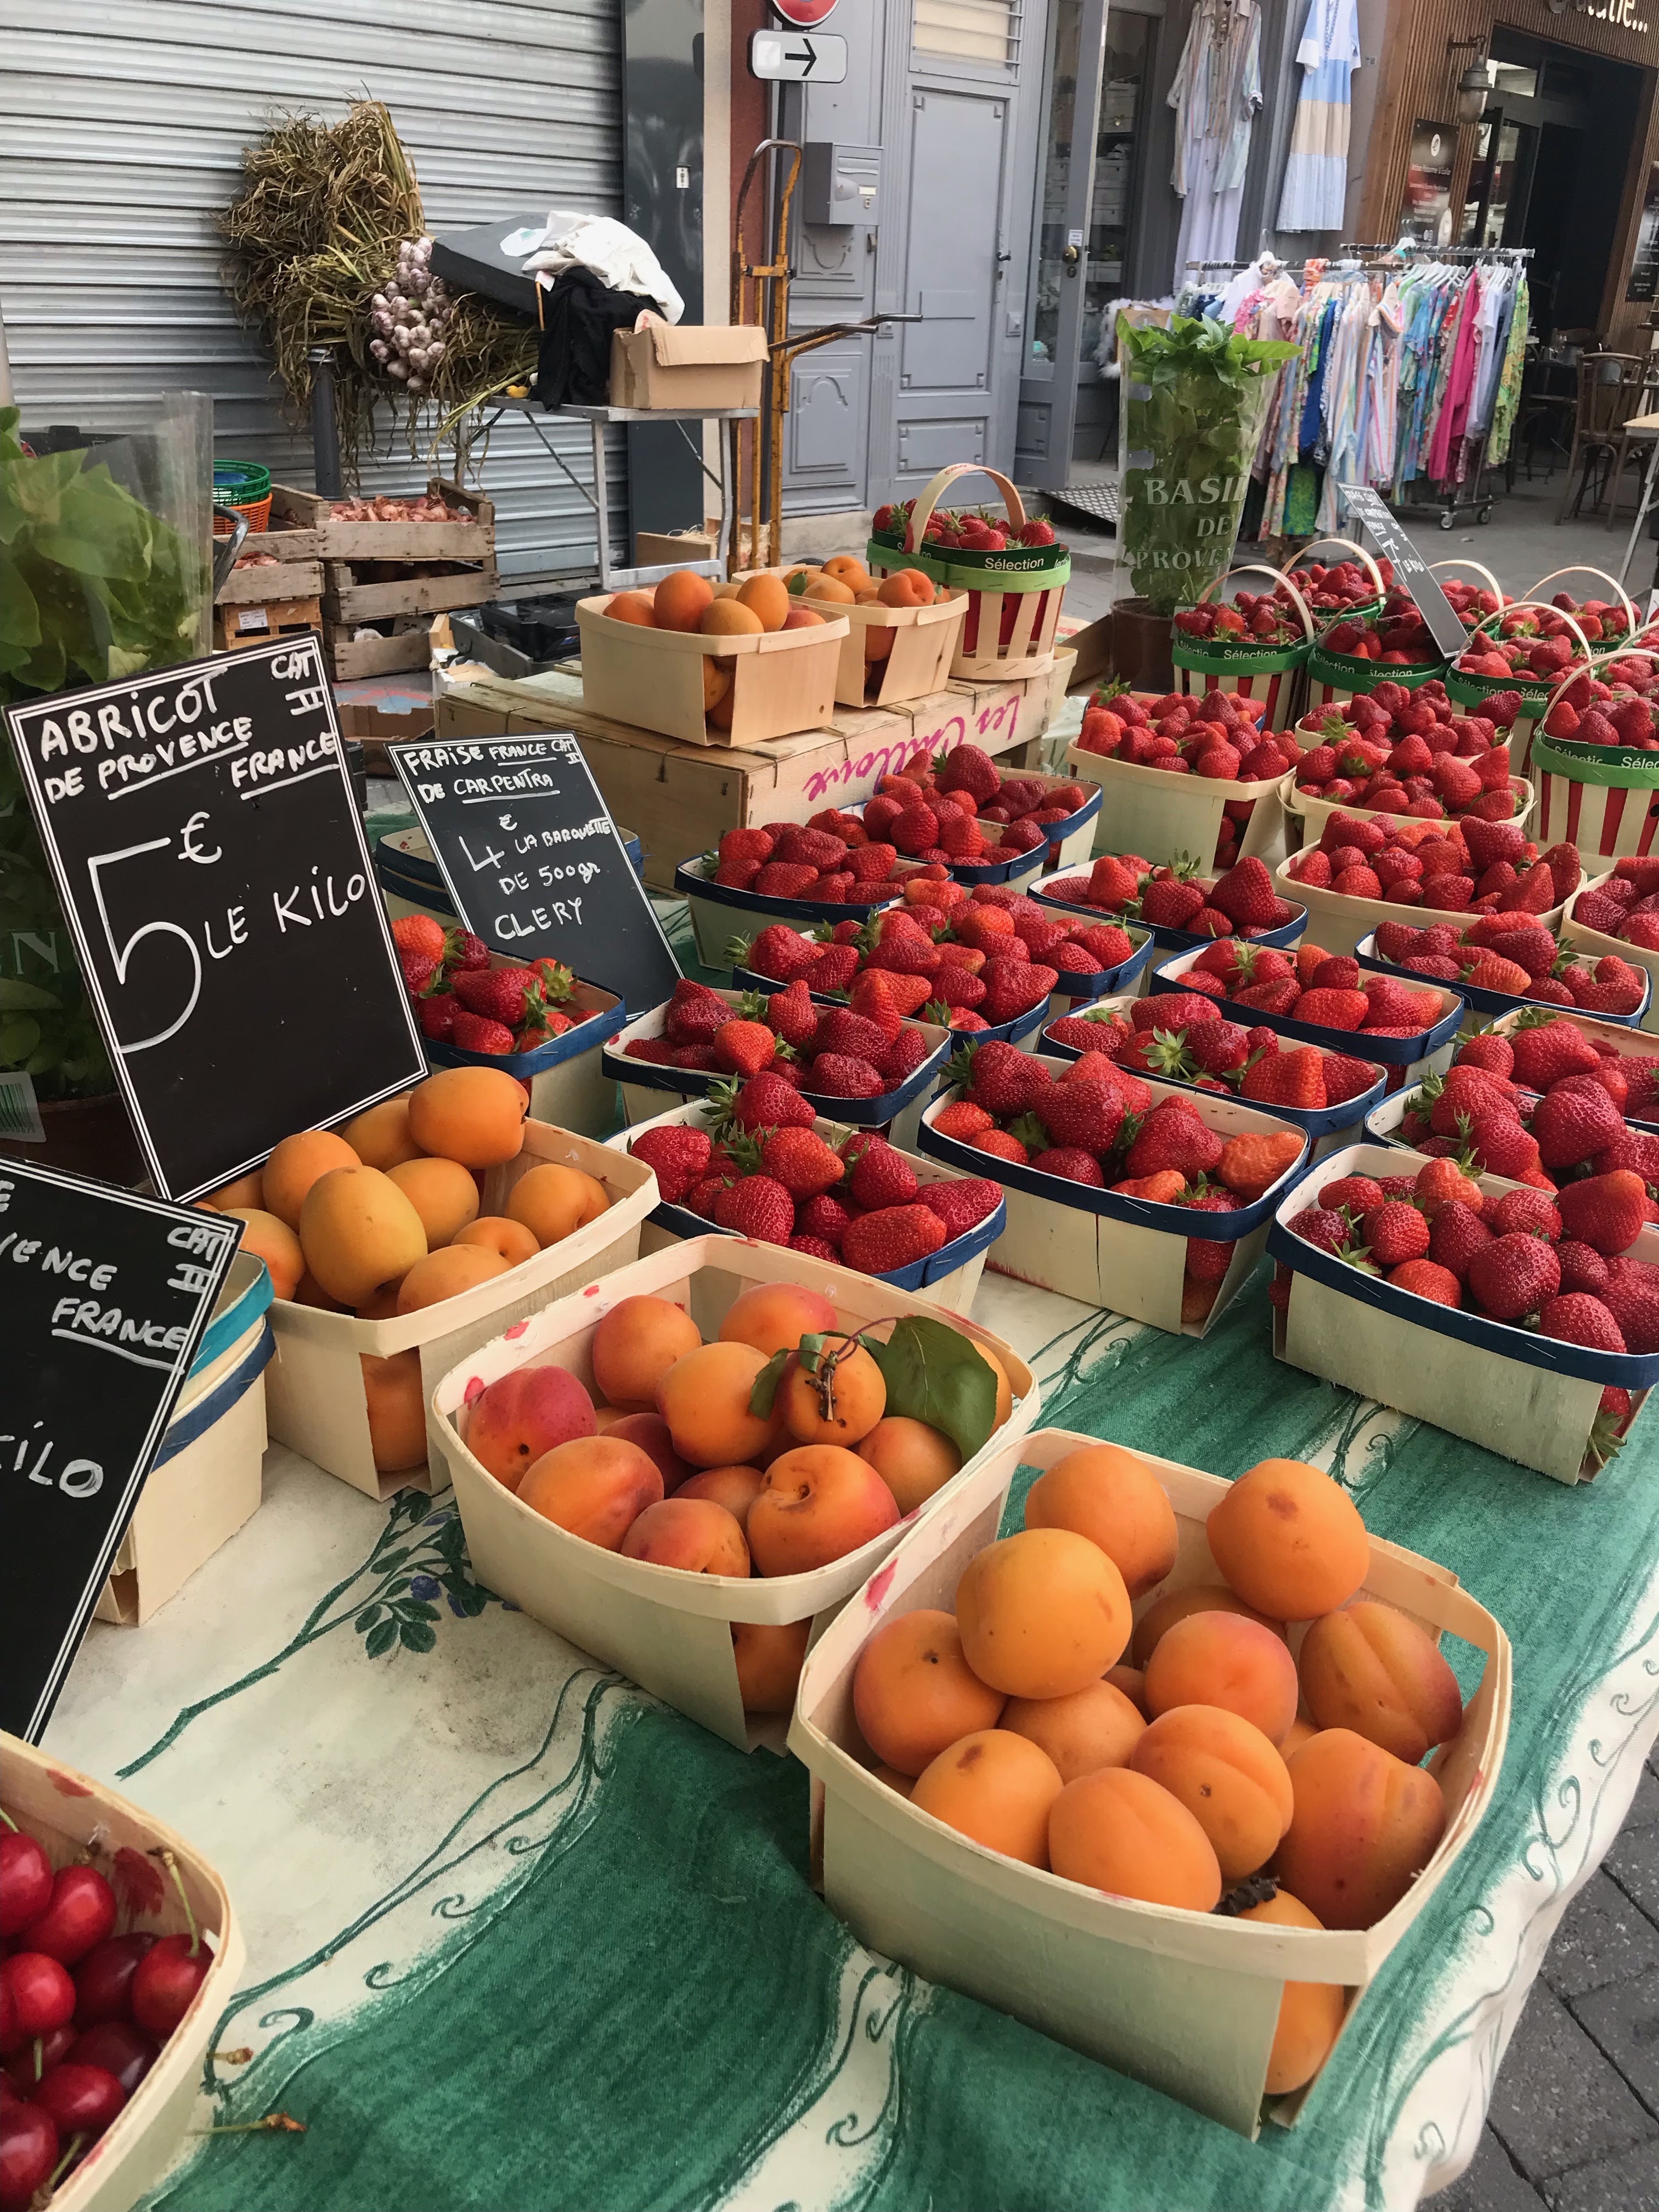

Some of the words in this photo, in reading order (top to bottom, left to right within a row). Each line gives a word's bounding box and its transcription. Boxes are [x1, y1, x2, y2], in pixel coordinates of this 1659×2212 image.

[1197, 514, 1234, 538] DE
[984, 556, 1044, 571] Sélection
[270, 651, 315, 680] CAT
[44, 766, 85, 804] DE
[98, 716, 253, 790] PROVENCE
[231, 732, 337, 788] FRANCE
[488, 743, 548, 763] FRANCE
[550, 738, 574, 753] CAT
[417, 782, 446, 805] DE
[453, 768, 555, 795] CARPENTRA
[515, 834, 538, 854] LA
[541, 816, 612, 847] BARQUETTE
[498, 871, 530, 896] DE
[538, 862, 601, 884] 500gr
[204, 906, 249, 959] LE
[494, 896, 583, 940] CLERY
[167, 1226, 235, 1262] CAT
[51, 1297, 189, 1351] FRANCE
